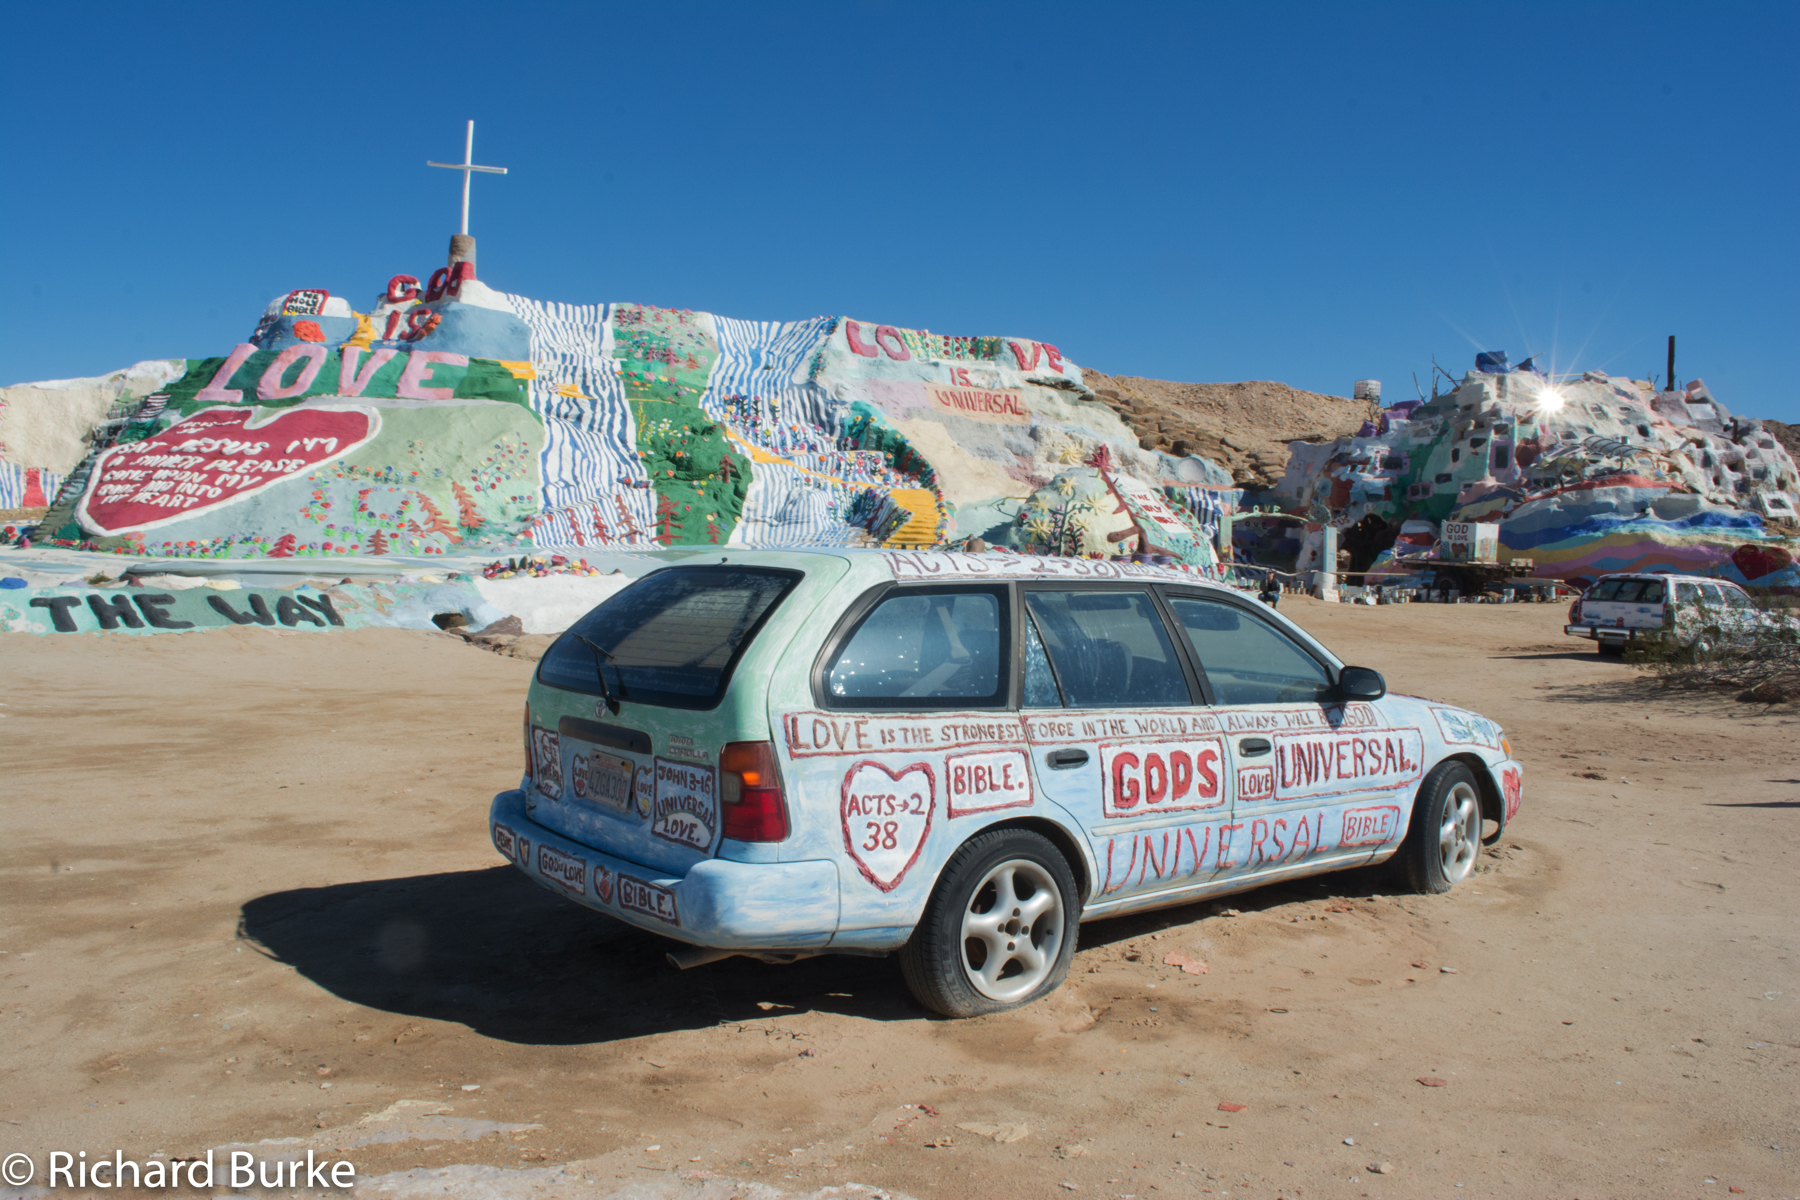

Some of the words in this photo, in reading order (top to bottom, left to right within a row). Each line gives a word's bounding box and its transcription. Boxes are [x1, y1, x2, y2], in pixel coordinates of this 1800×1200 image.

[287, 305, 317, 315] BIBLE
[288, 296, 319, 307] HOLY
[382, 308, 432, 341] IS
[194, 343, 470, 403] LOVE
[950, 367, 971, 387] IS
[935, 389, 1024, 415] UNIVERSAL
[168, 438, 269, 455] JESUS
[107, 455, 125, 468] A
[129, 455, 204, 469] SINNER
[203, 458, 306, 474] PLEASE
[103, 469, 152, 481] COME
[152, 469, 208, 485] UPON
[214, 473, 262, 489] MY
[175, 482, 222, 498] INTO
[127, 492, 198, 508] HEART
[1446, 523, 1468, 534] GOD
[29, 593, 194, 633] THE
[206, 593, 345, 627] WAY
[1346, 705, 1375, 727] GOD
[669, 734, 694, 747] TOYOTA
[791, 716, 873, 750] LOVE
[880, 728, 895, 744] IS
[899, 727, 934, 744] THE
[1029, 721, 1075, 739] FORCE
[1081, 721, 1097, 737] IN
[1096, 718, 1129, 736] THE
[1134, 716, 1187, 734] WORLD
[1191, 716, 1216, 732] AND
[1227, 714, 1278, 731] ALWAYS
[1284, 712, 1314, 728] WILL
[668, 745, 710, 760] COROLLA
[637, 782, 653, 797] LOVE
[658, 766, 688, 788] JOHN
[689, 773, 711, 795] 3-16
[954, 763, 1024, 795] BIBLE.
[1112, 749, 1218, 809] GODS
[1241, 773, 1270, 795] LOVE
[658, 795, 714, 828] UNIVERSAL
[663, 817, 700, 842] LOVE.
[863, 820, 899, 851] 38
[1346, 814, 1390, 840] BIBLE
[1103, 812, 1329, 893] UNIVERSAL
[542, 853, 559, 872] GOD
[564, 866, 583, 885] LOVE
[624, 881, 672, 917] BIBLE.
